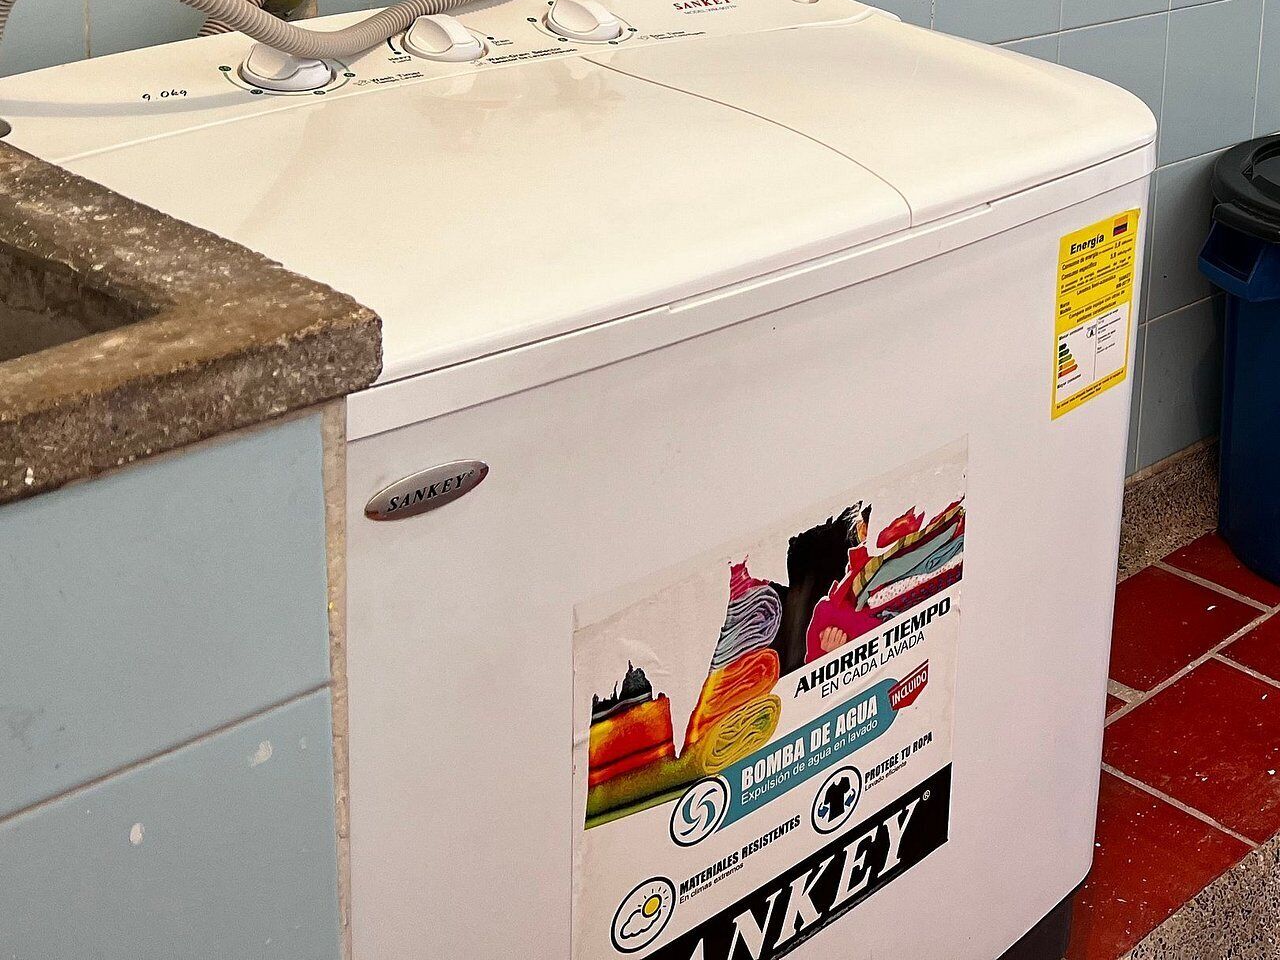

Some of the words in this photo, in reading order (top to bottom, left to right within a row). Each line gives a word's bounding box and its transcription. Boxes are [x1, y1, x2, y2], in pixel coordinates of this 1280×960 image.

[1070, 233, 1104, 255] Energía
[387, 473, 466, 512] SANKEY
[794, 636, 879, 698] AHORRE
[883, 596, 951, 647] TIEMPO
[821, 676, 839, 698] EN
[843, 659, 878, 685] CADA
[881, 630, 925, 665] LAVADA
[891, 670, 928, 707] INCLUIDO
[741, 737, 805, 792] BOMBA
[810, 722, 831, 752] DE
[835, 695, 878, 739] AGUA
[741, 771, 790, 805] Expulsión
[793, 762, 806, 777] de
[808, 748, 832, 768] agua
[834, 739, 846, 751] en
[849, 719, 878, 744] lavado
[864, 752, 899, 784] PROTEGE
[901, 745, 911, 760] TU
[912, 731, 933, 753] ROPA
[679, 851, 739, 896] MATERIALES
[741, 814, 801, 859] RESISTENTES
[679, 893, 690, 905] En
[690, 881, 713, 898] climas
[713, 862, 744, 885] extremos
